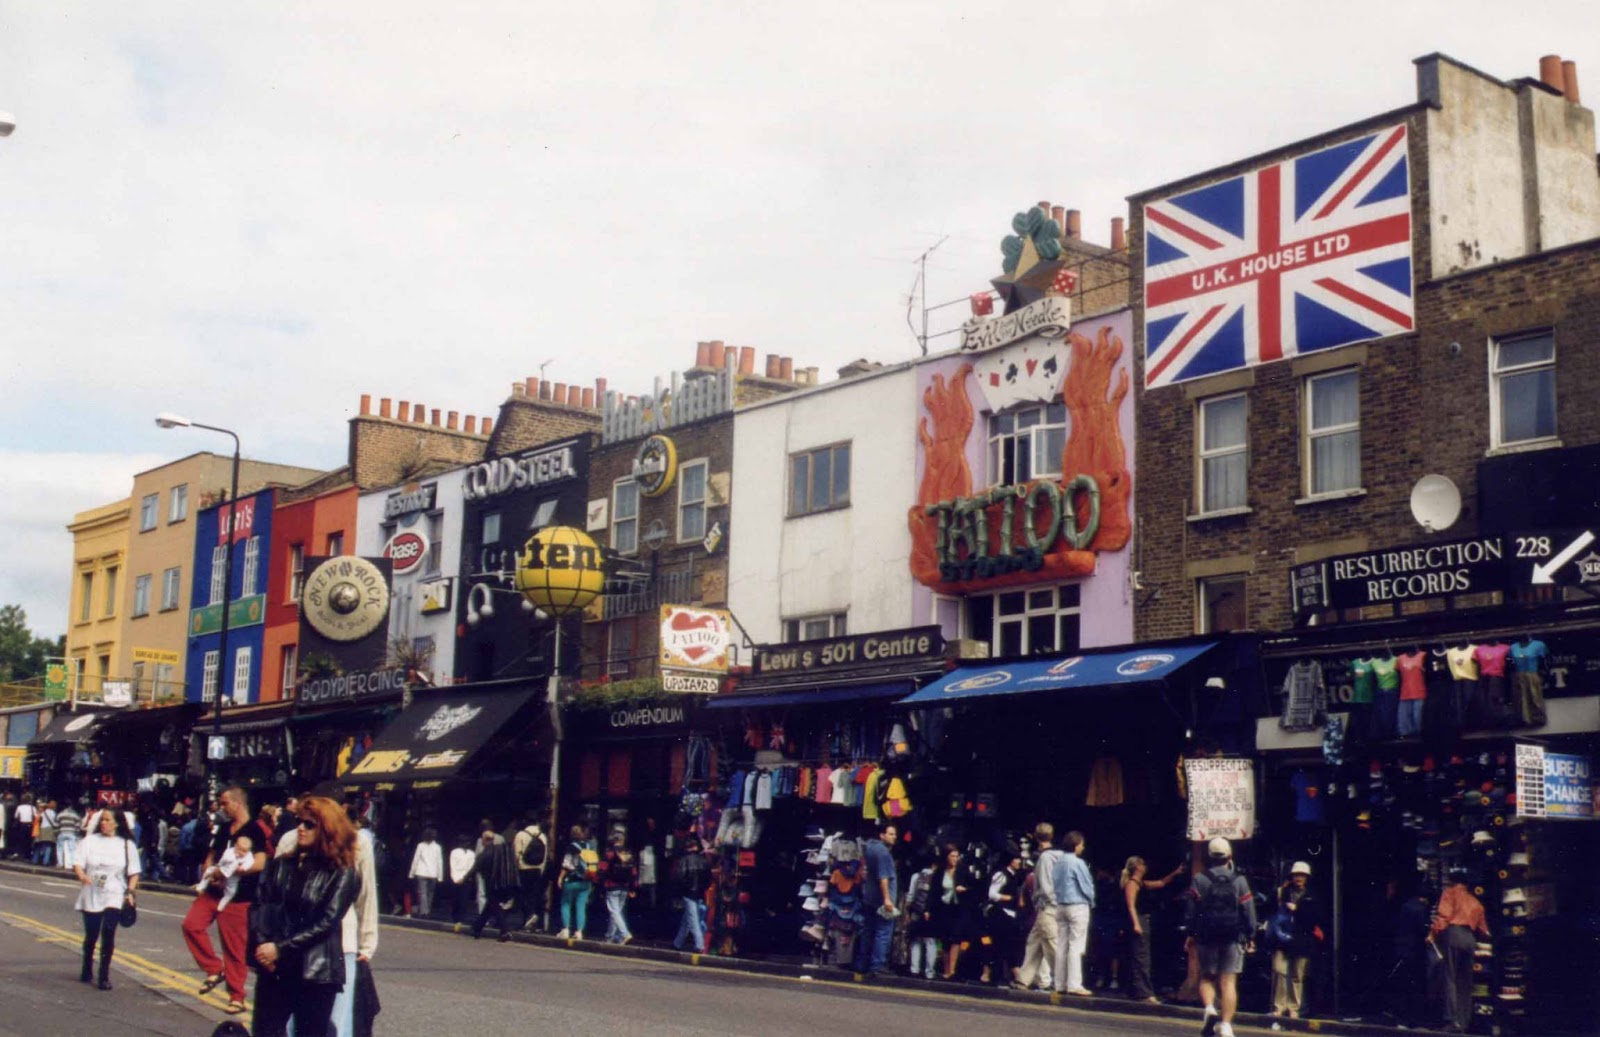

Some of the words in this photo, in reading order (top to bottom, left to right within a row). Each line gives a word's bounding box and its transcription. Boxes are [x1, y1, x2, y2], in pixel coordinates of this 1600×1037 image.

[1192, 267, 1235, 290] U.K.
[1240, 245, 1307, 277] HOUSE
[1313, 234, 1350, 258] LTD
[961, 320, 1001, 350] Evil
[1011, 298, 1066, 337] Needle
[1334, 538, 1502, 580] RESURRECTION
[1515, 536, 1550, 557] 228
[310, 564, 338, 606] NEW
[355, 565, 381, 609] ROCK
[1367, 569, 1470, 600] RECORDS
[821, 641, 856, 664] 501
[863, 636, 930, 660] Centre
[302, 668, 404, 701] BODYPIERCING
[611, 706, 684, 727] COMPENDIUM
[1545, 759, 1589, 778] BUREAU
[1545, 784, 1592, 803] CHANGE
